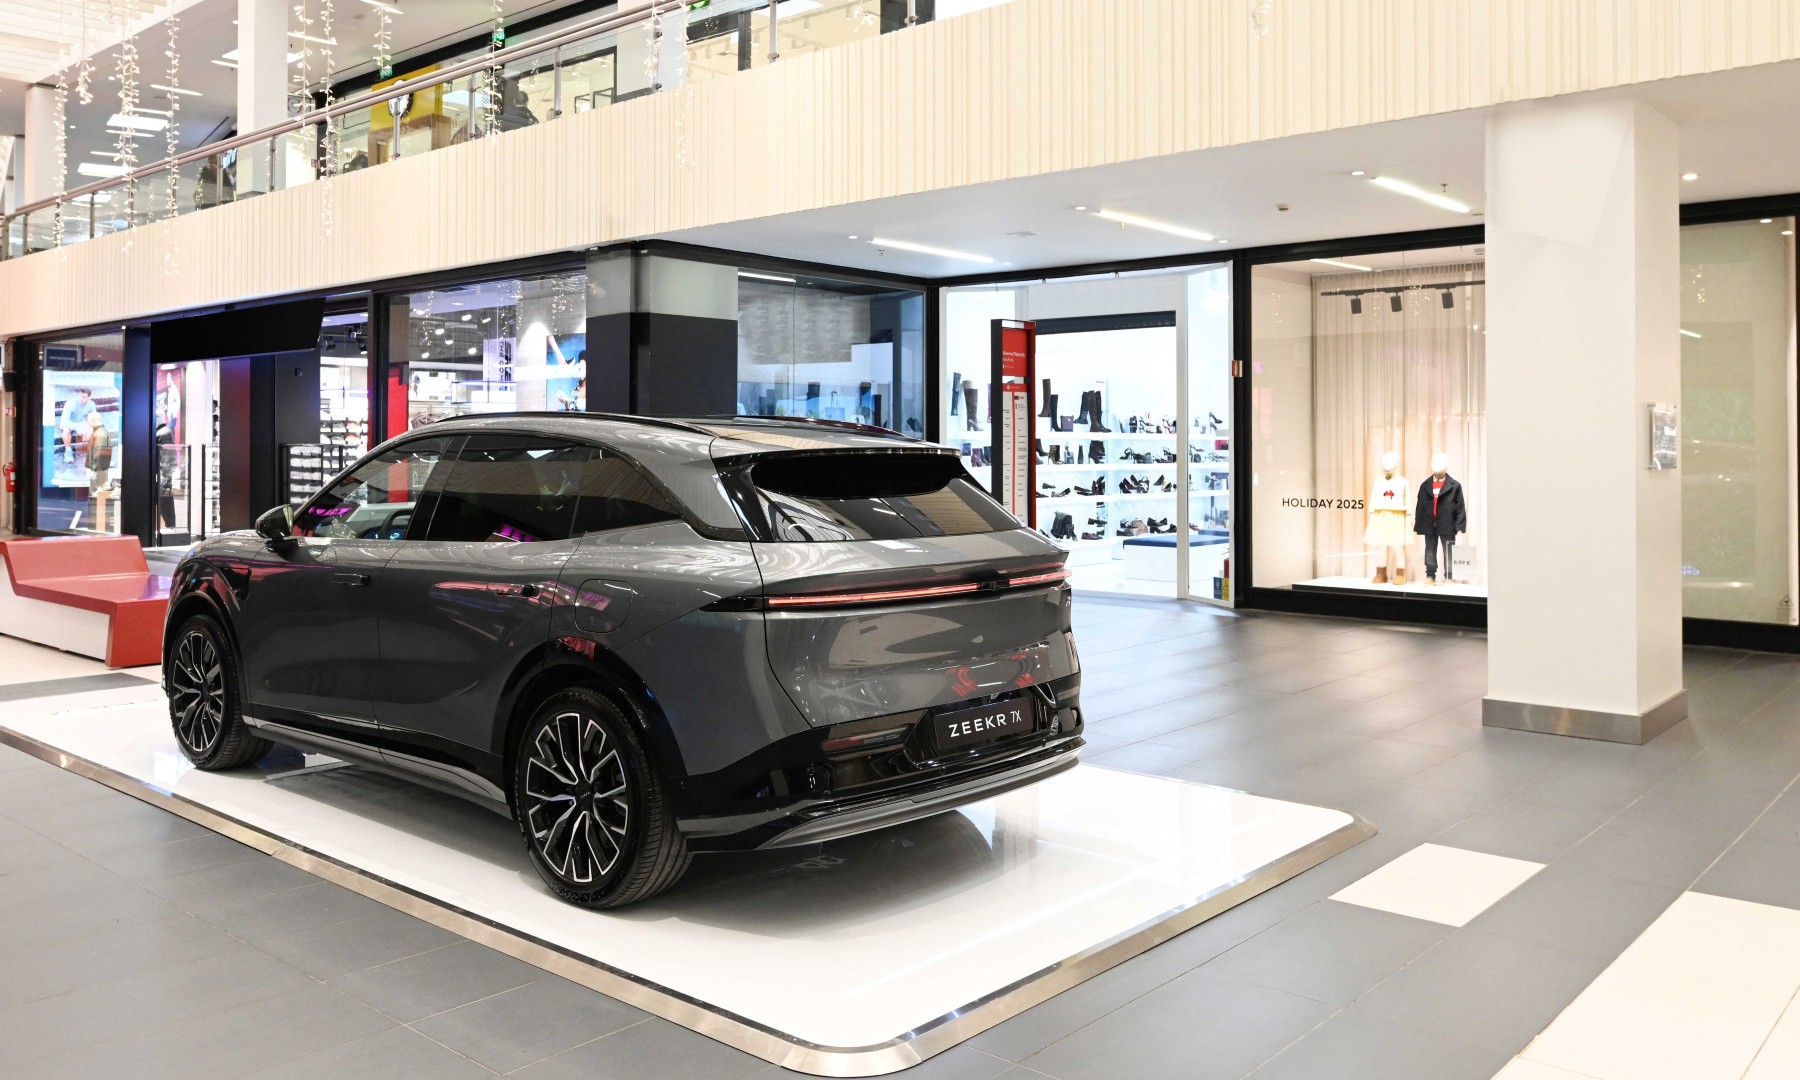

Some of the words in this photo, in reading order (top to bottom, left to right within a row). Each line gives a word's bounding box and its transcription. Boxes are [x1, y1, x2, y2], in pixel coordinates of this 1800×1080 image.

[1282, 497, 1333, 509] HOLIDAY
[1336, 499, 1365, 510] 2025
[948, 713, 1007, 738] ZEEKR
[1010, 709, 1022, 723] 7X
